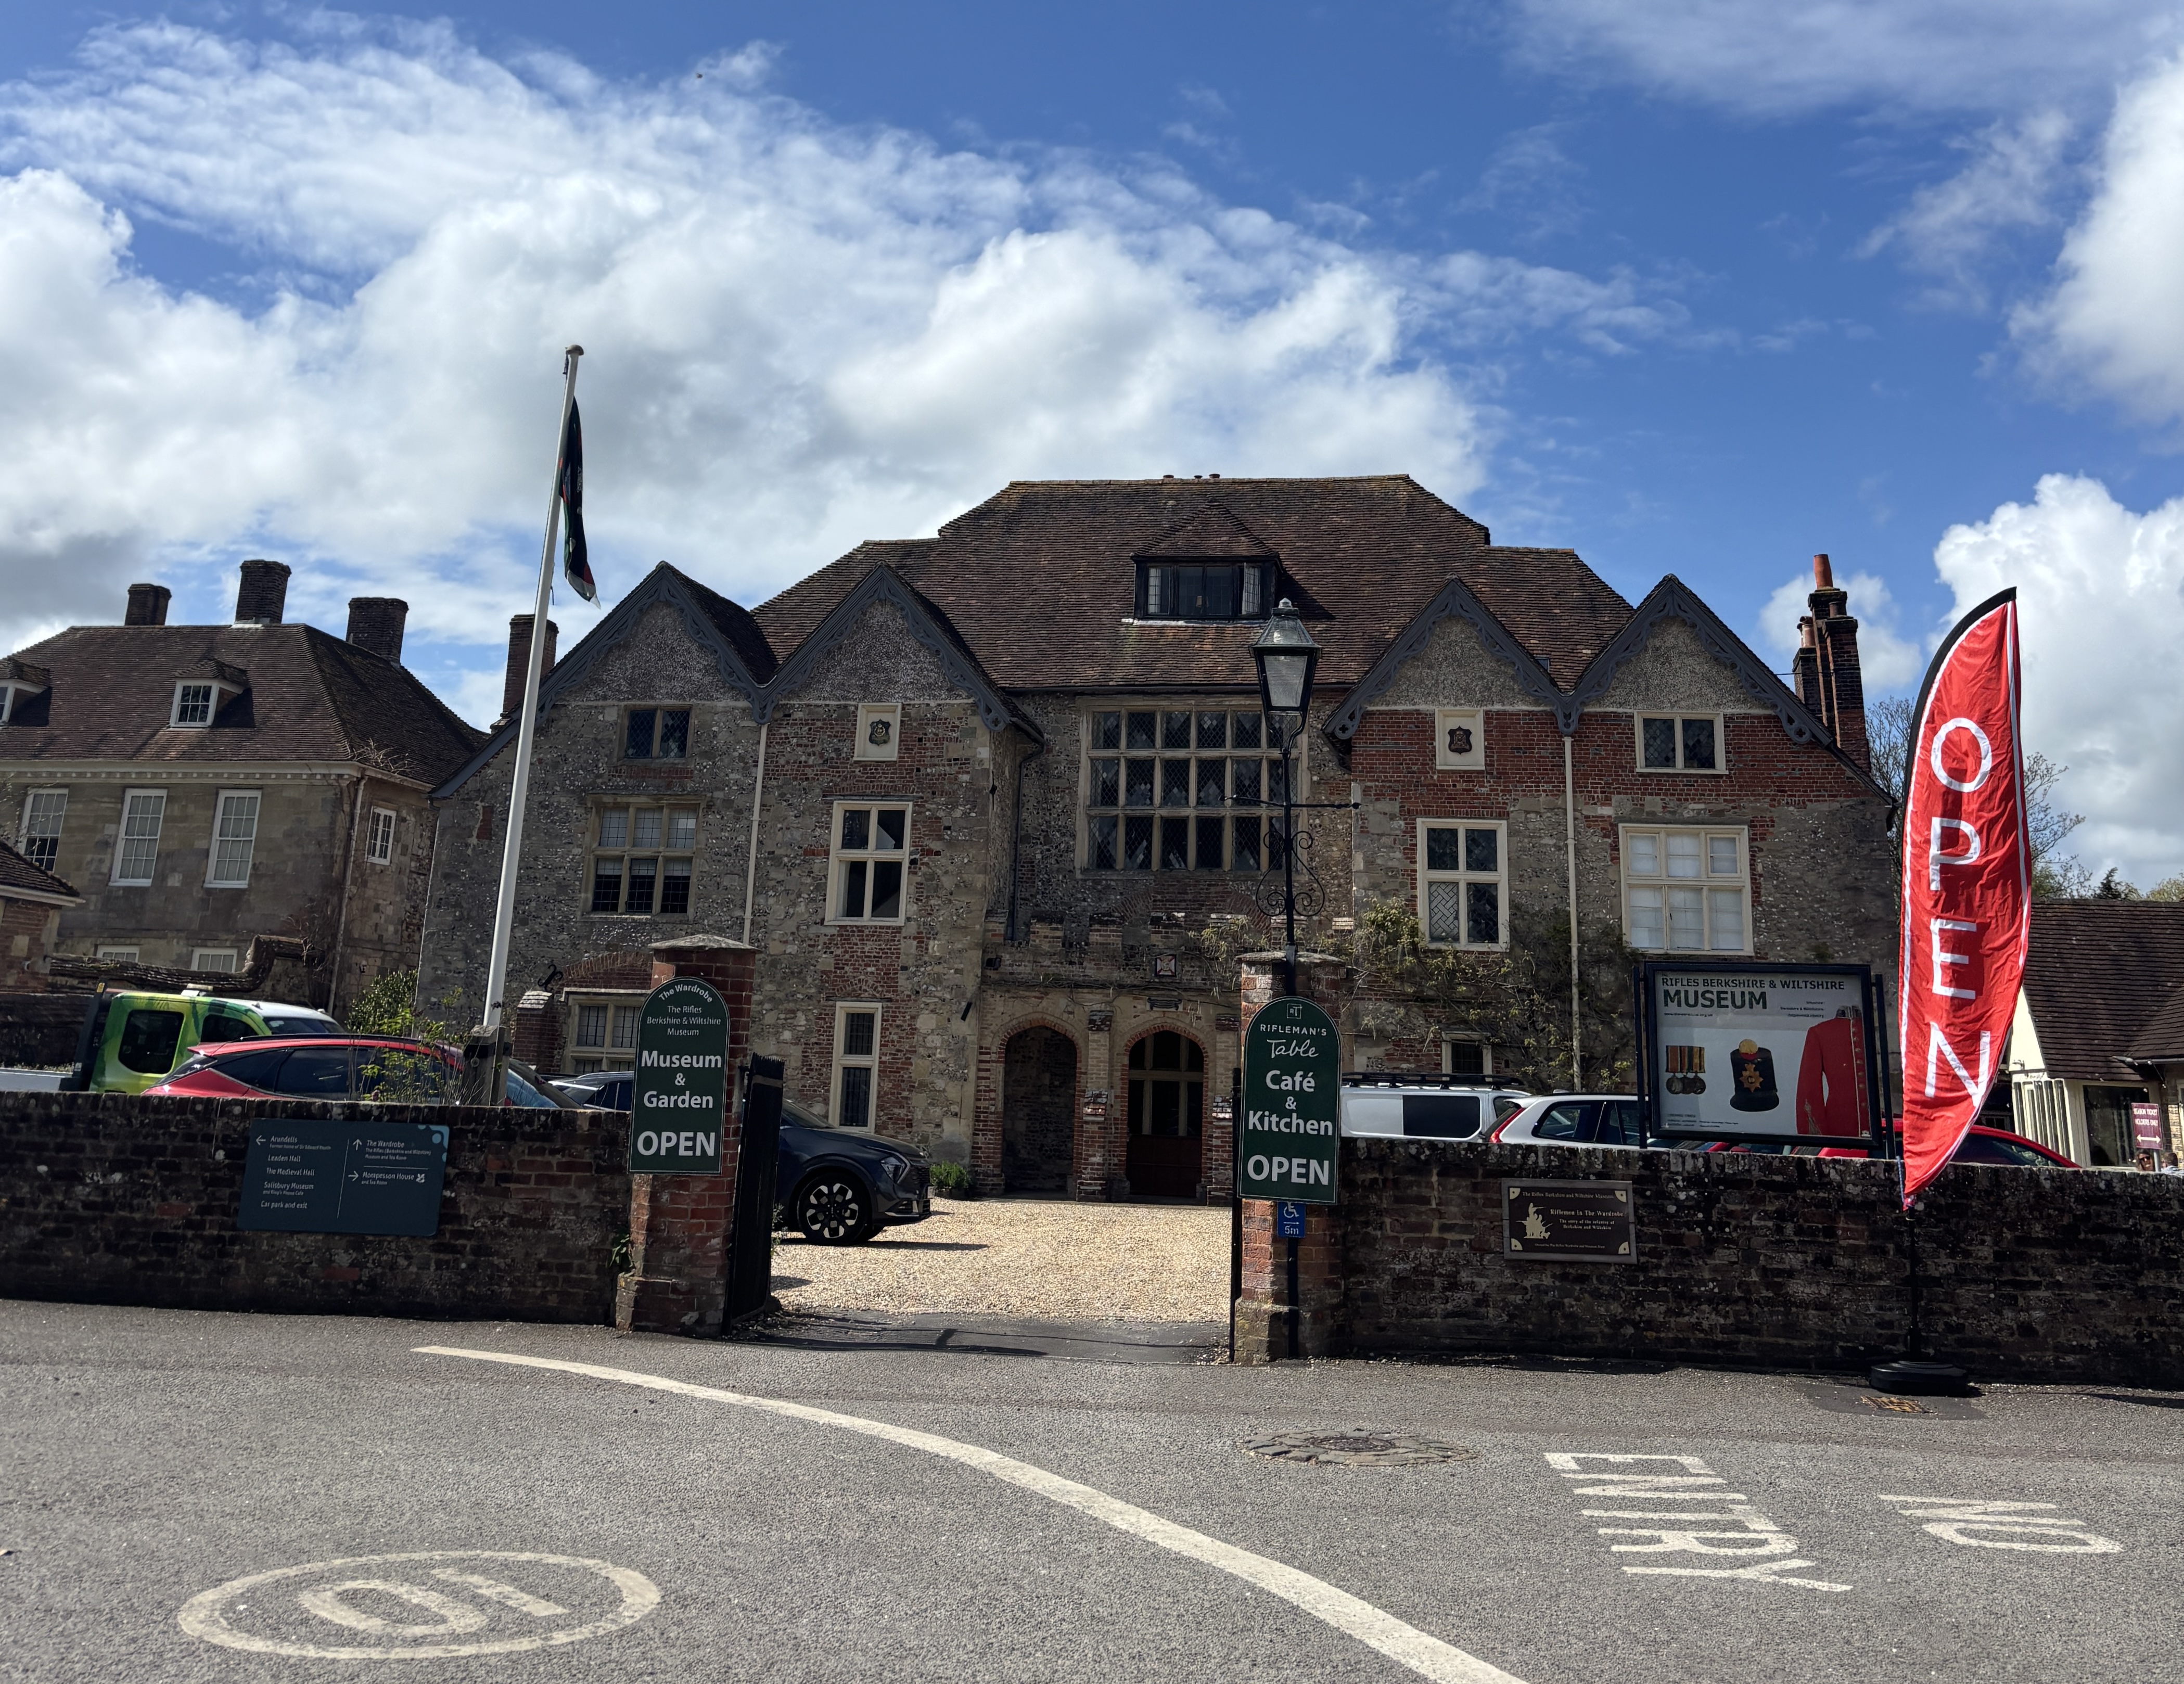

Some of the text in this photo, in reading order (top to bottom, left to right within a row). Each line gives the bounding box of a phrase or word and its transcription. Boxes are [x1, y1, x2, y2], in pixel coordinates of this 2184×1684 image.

[1924, 718, 1993, 1107] OPEN
[1662, 977, 1845, 990] RIFLES BERKSHIRE & WILTSHIRE
[659, 984, 712, 1003] The Wardrobe
[1663, 989, 1767, 1009] MUSEUM
[1260, 1024, 1327, 1036] RIFLEMAN'S
[1267, 1039, 1319, 1058] Table
[641, 1050, 721, 1068] Museum
[675, 1073, 685, 1086] &
[1266, 1070, 1315, 1092] Café
[644, 1091, 713, 1108] Garden
[1285, 1096, 1296, 1110] &
[1248, 1111, 1333, 1136] Kitchen
[637, 1131, 716, 1156] OPEN
[1247, 1154, 1329, 1185] OPEN
[264, 1181, 290, 1190] Salisbury
[1284, 1225, 1299, 1234] 5m
